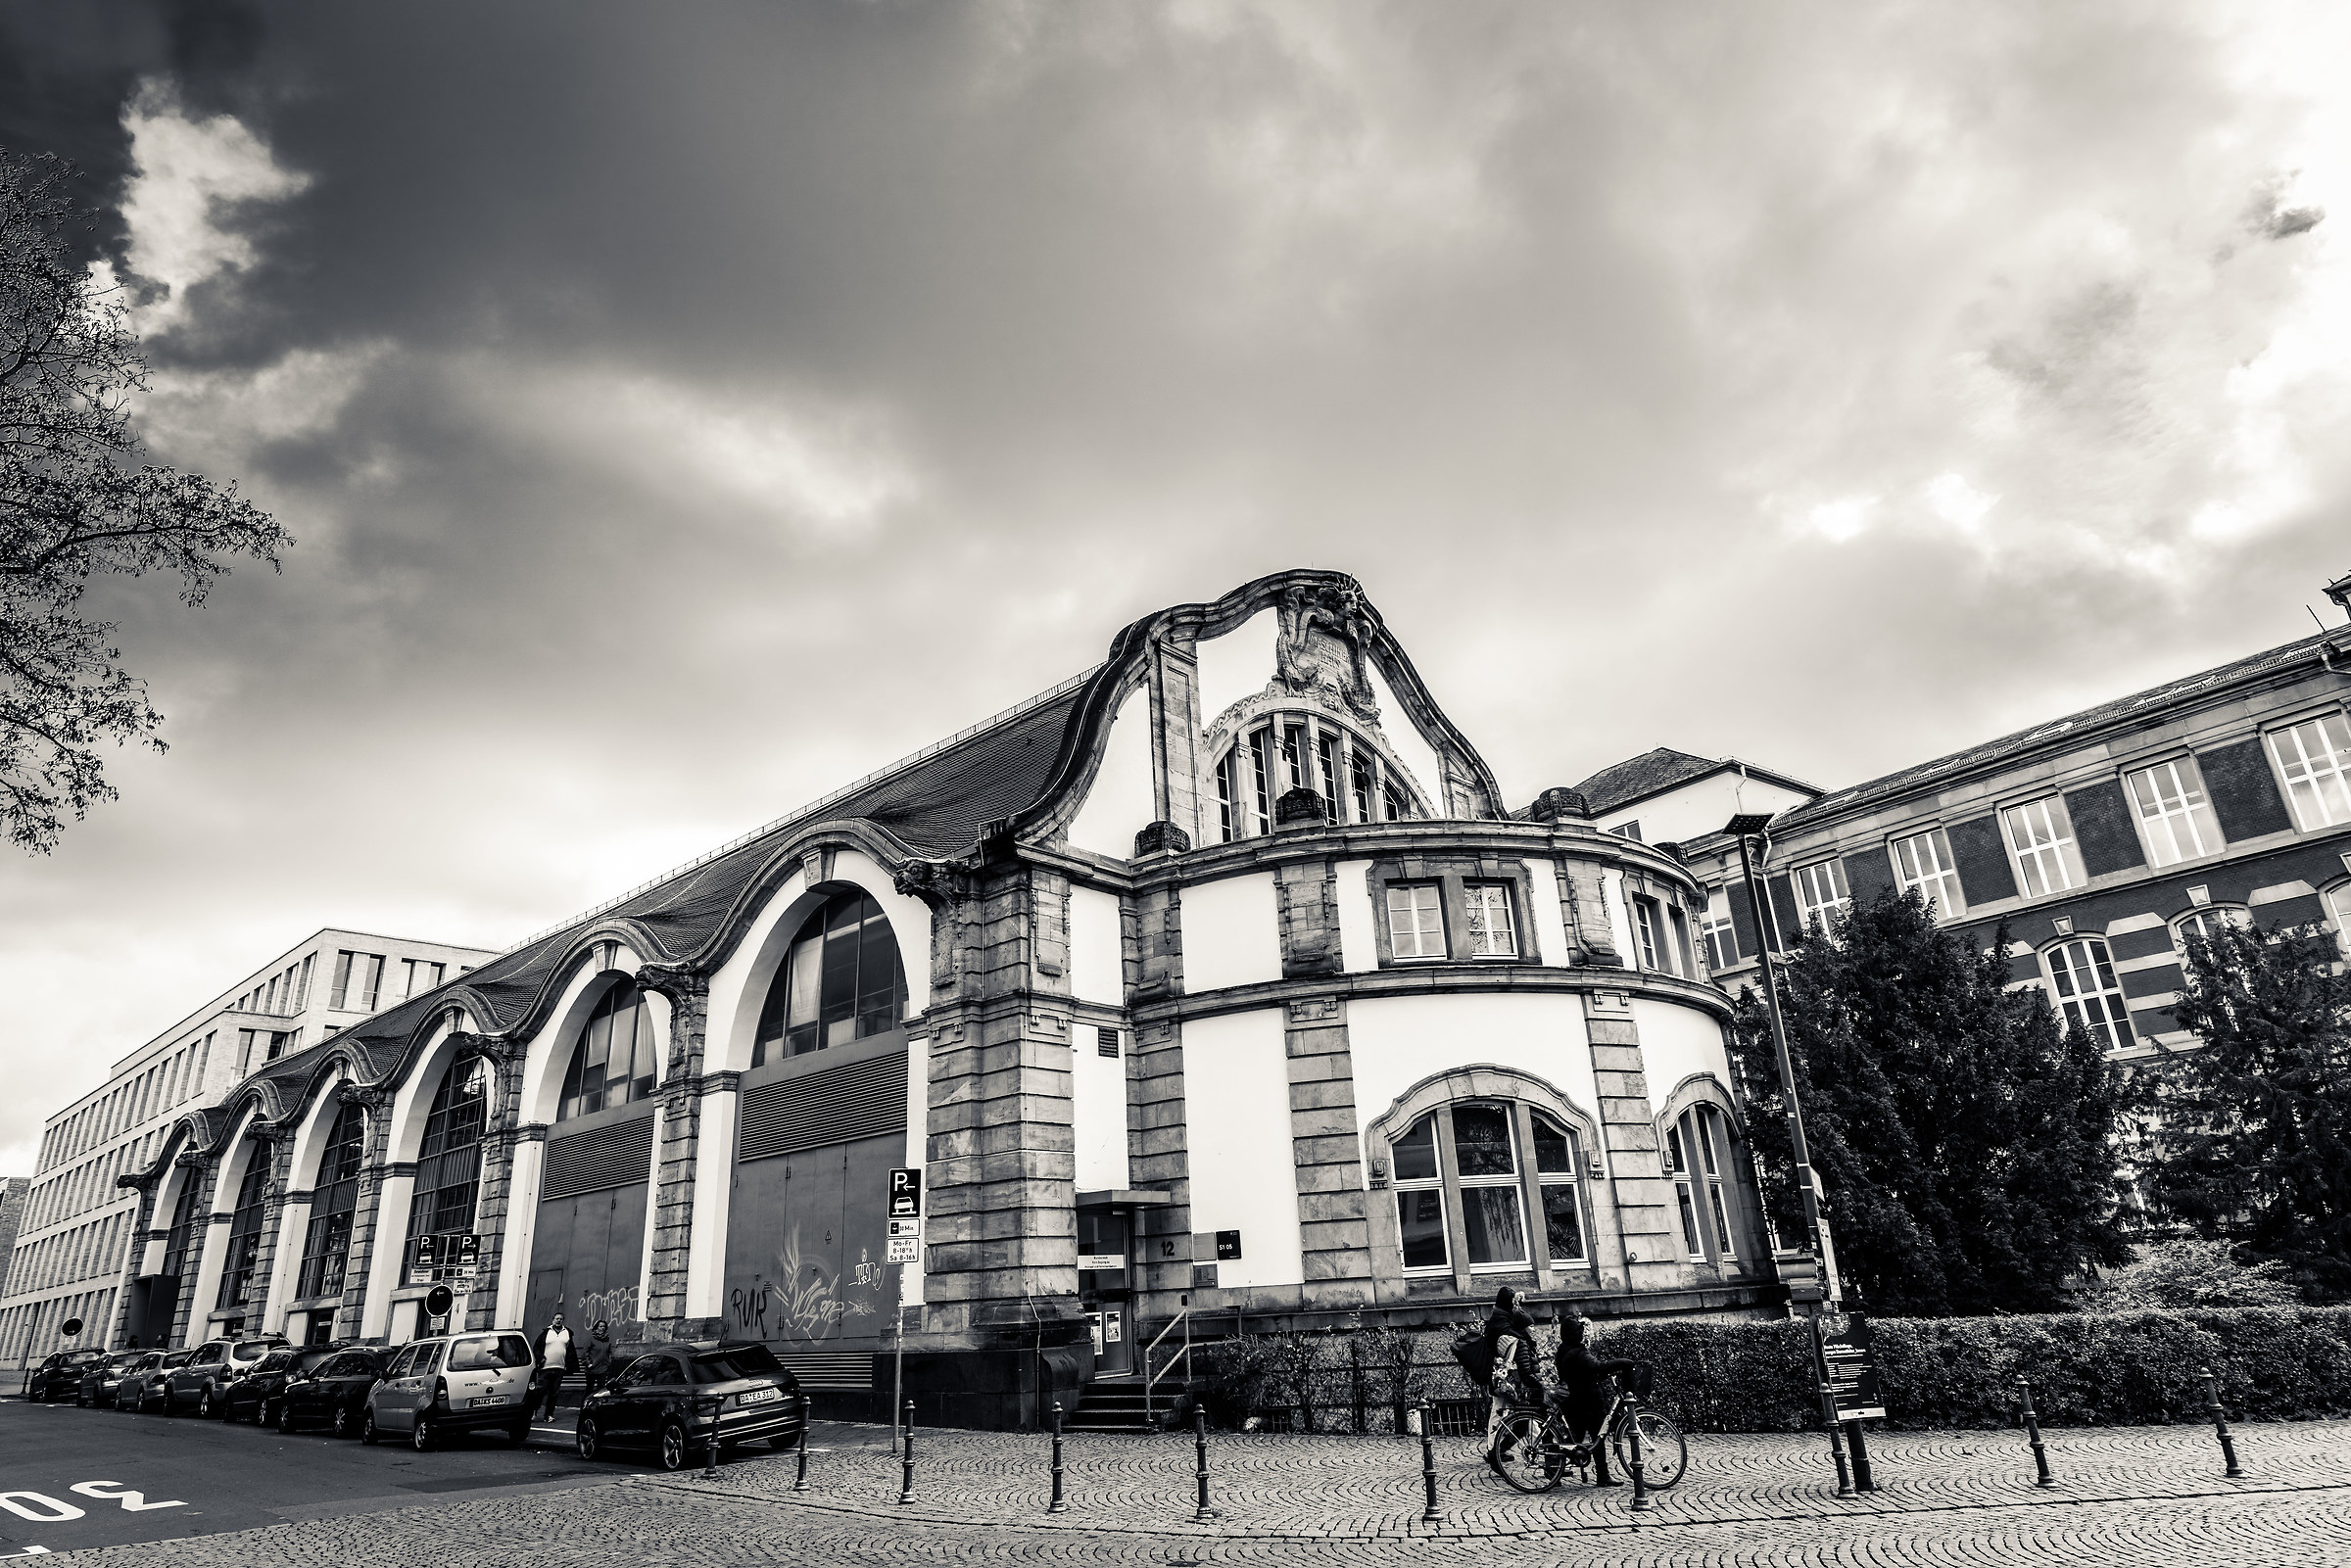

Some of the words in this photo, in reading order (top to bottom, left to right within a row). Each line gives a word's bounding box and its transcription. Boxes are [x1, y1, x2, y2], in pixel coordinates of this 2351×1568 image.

[894, 1172, 908, 1192] P
[420, 1236, 430, 1249] P
[461, 1236, 472, 1249] P
[1161, 1240, 1176, 1257] 12
